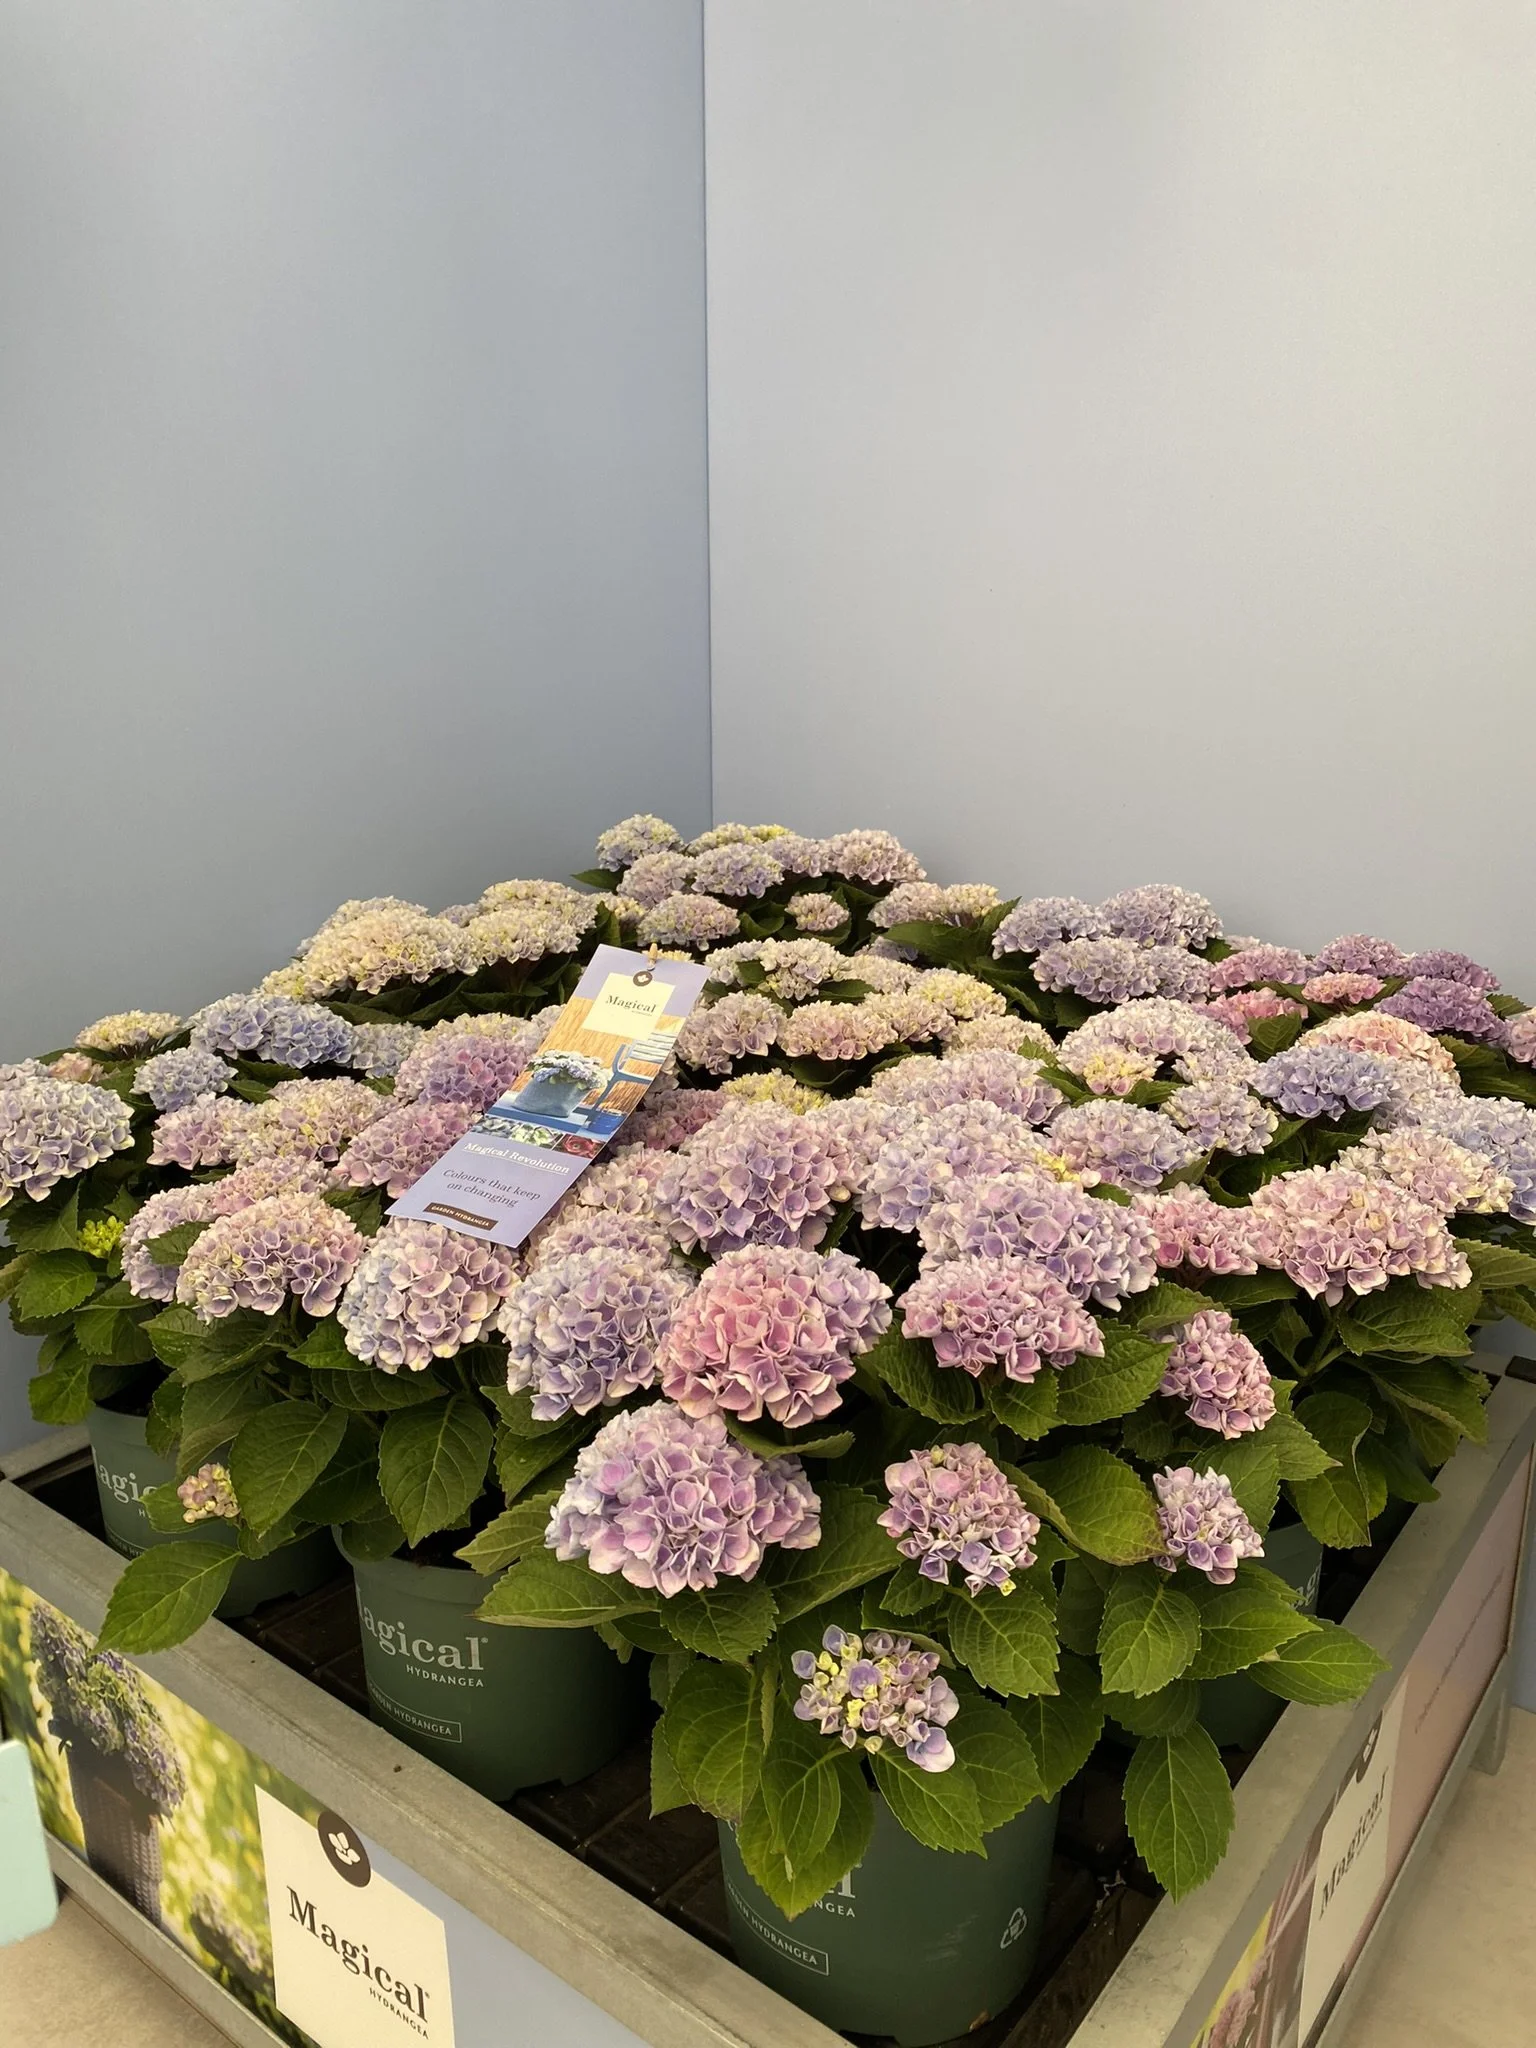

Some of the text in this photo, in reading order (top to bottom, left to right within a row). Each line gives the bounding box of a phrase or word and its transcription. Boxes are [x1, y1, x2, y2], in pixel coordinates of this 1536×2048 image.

[605, 995, 657, 1013] Magical
[464, 1142, 571, 1174] Magical Revolution
[443, 1169, 541, 1201] Colours that keep
[447, 1182, 519, 1208] on changing
[406, 1664, 484, 1688] HYDRANGEA
[393, 1707, 452, 1736] HYDRANGEA
[286, 1884, 429, 2024] Magical
[751, 1915, 818, 1966] HYDRANGEA
[369, 1986, 429, 2040] HYDRANGEA
